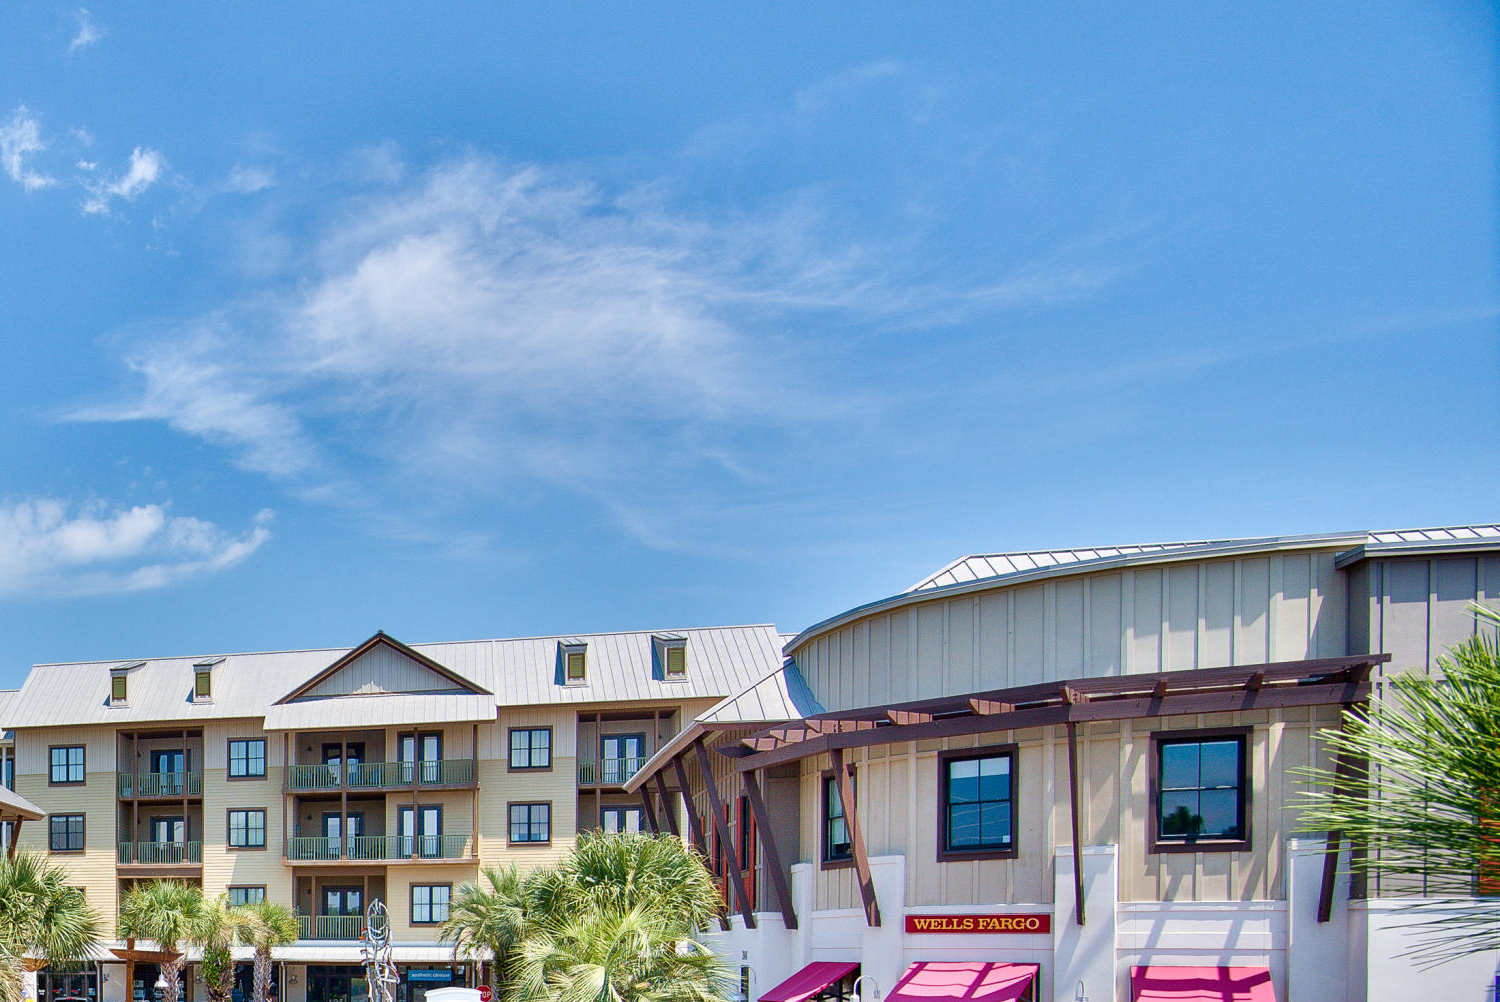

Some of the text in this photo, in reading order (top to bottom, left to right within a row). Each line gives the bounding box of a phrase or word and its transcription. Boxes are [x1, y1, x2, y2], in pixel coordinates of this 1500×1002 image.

[913, 918, 1039, 930] WELLS FARGO
[482, 991, 491, 999] OP
